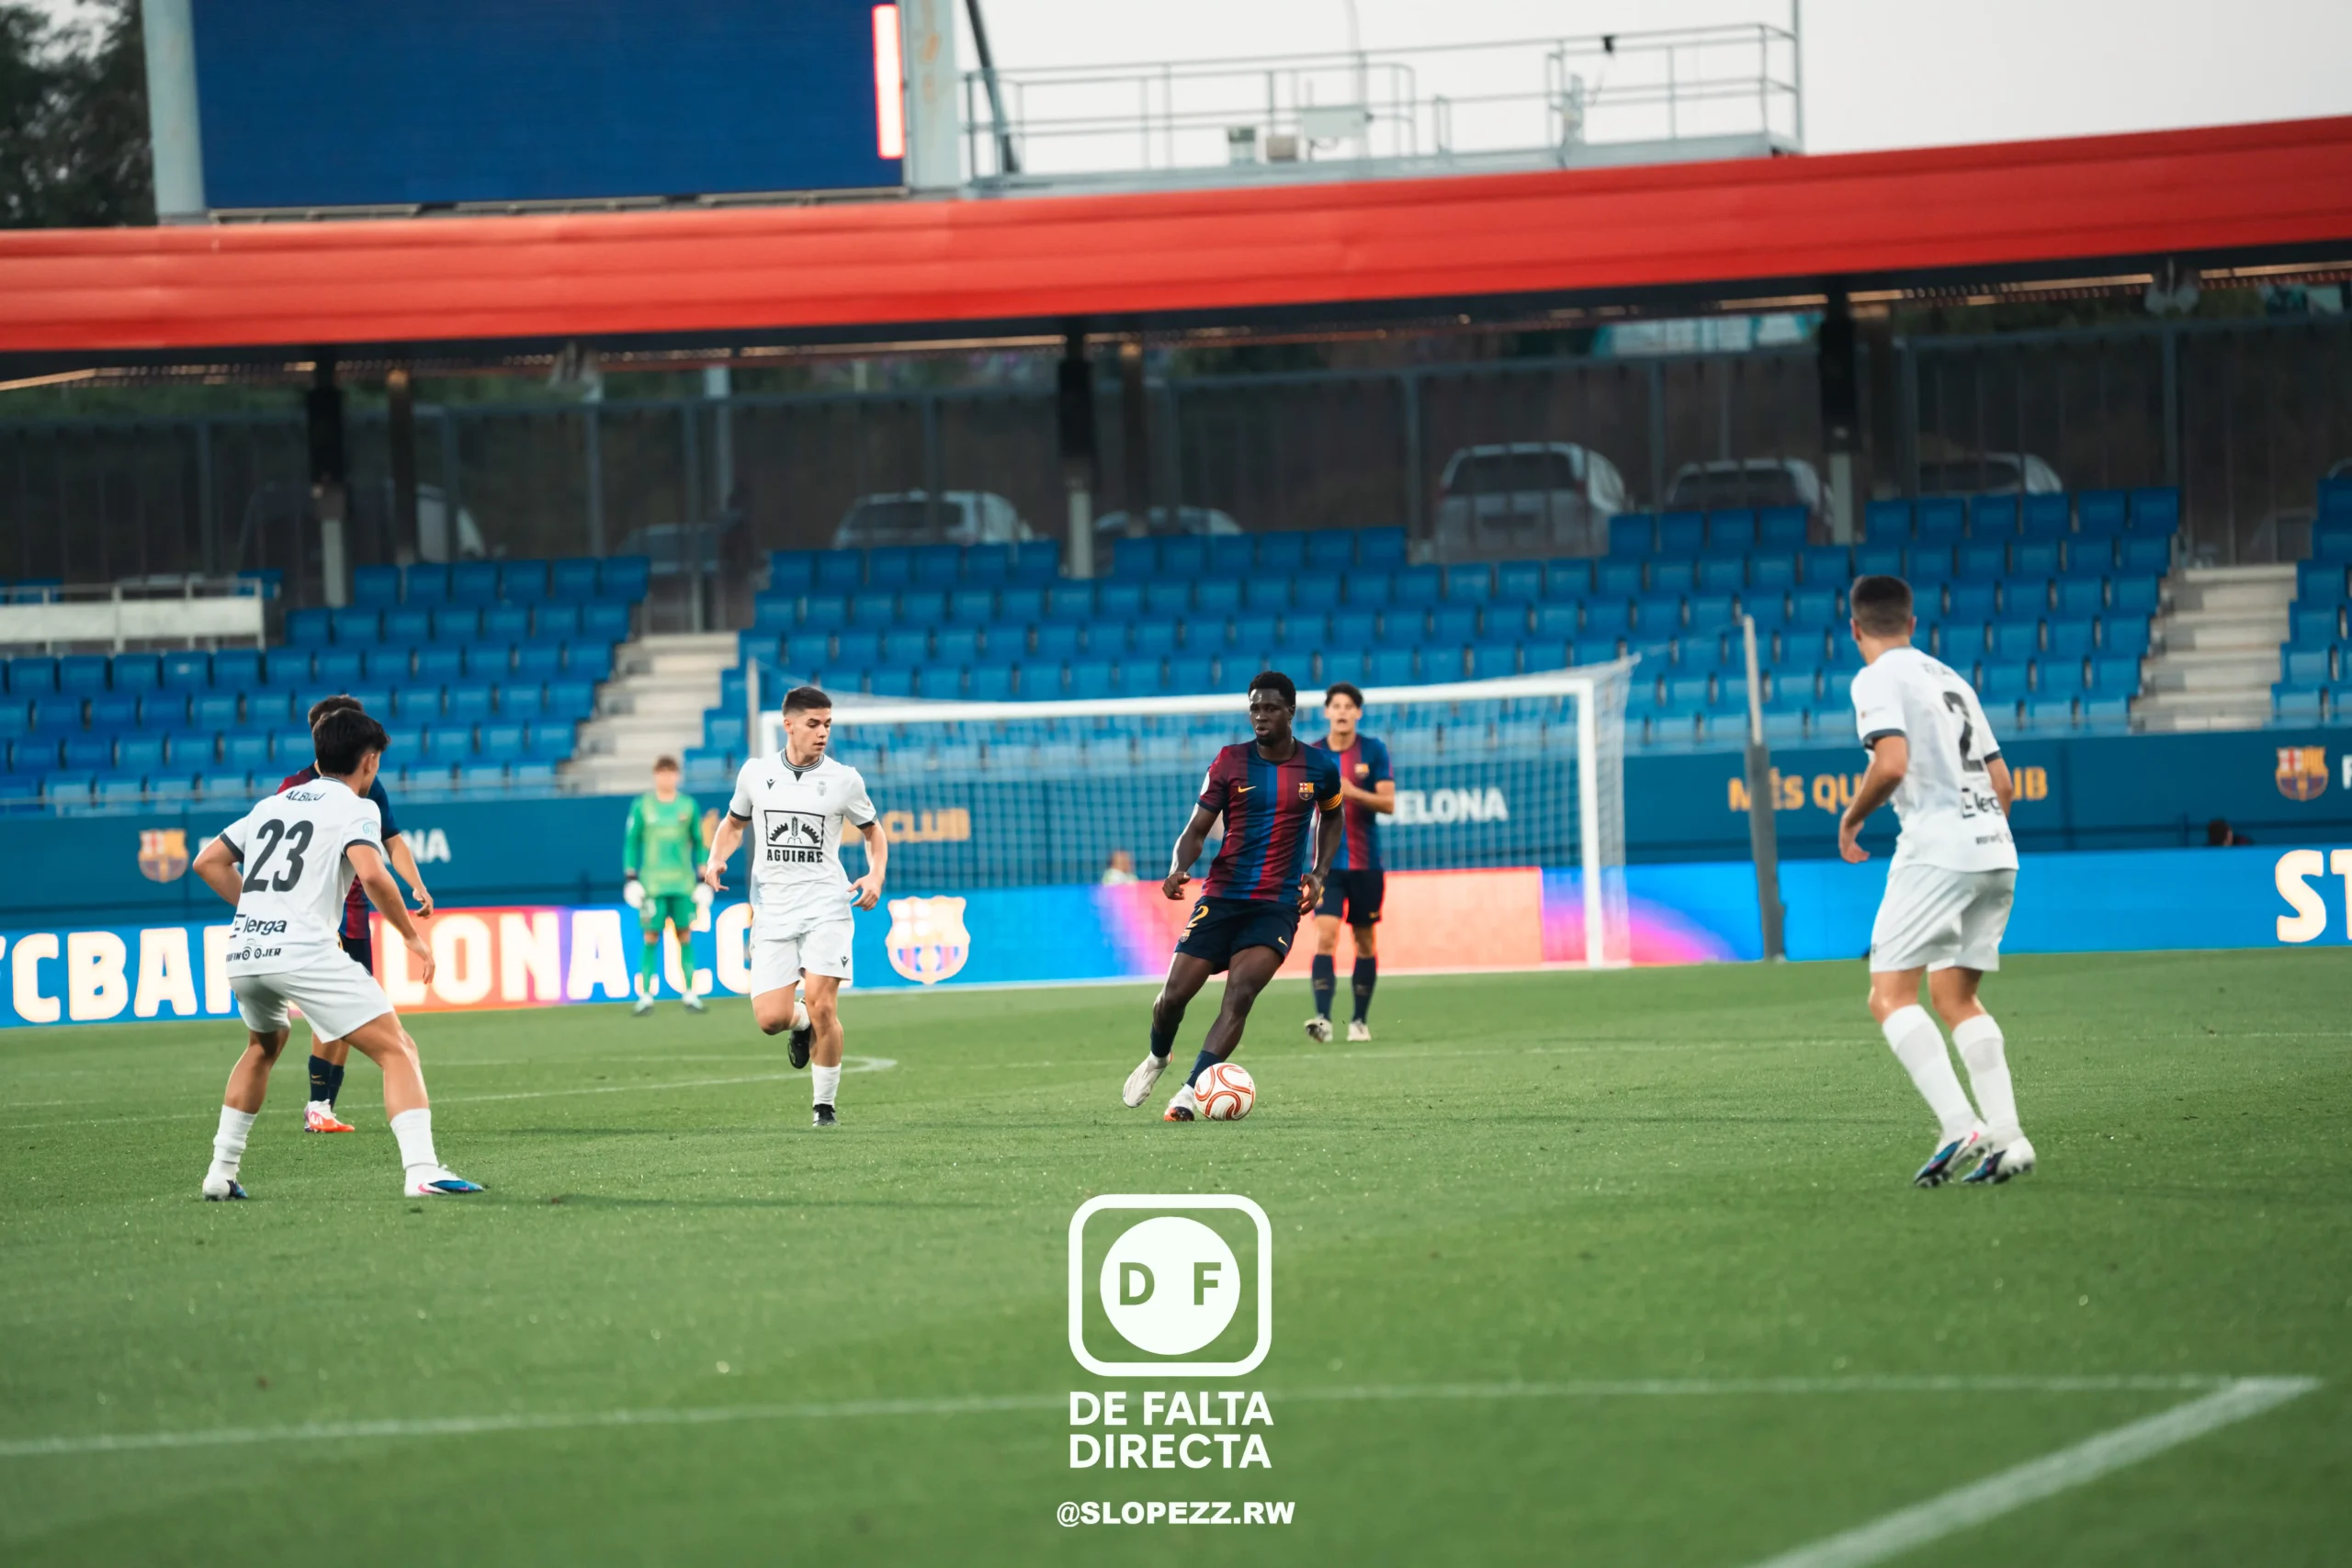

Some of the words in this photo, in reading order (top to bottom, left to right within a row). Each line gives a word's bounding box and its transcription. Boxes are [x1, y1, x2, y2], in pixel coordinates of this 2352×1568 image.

[1942, 691, 1984, 772] 2
[242, 818, 314, 894] 23
[766, 849, 823, 863] AGUIRRE
[1186, 905, 1209, 929] 2
